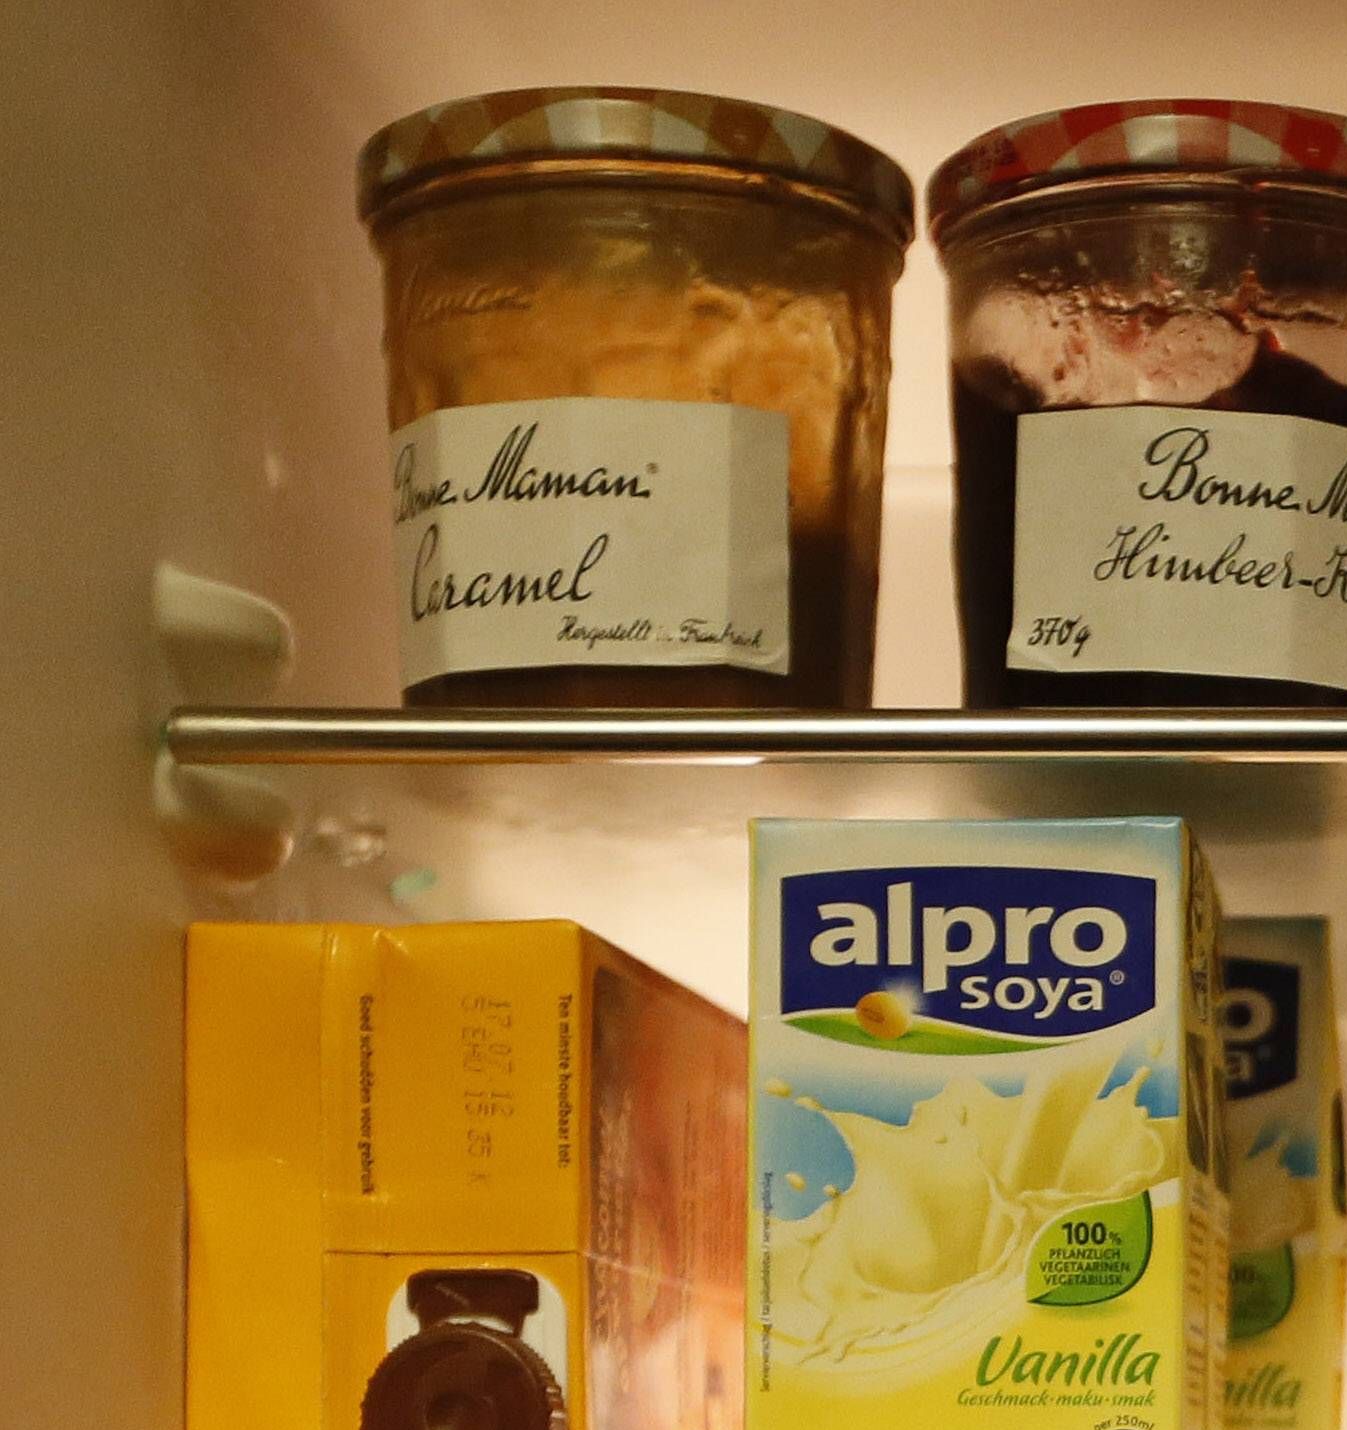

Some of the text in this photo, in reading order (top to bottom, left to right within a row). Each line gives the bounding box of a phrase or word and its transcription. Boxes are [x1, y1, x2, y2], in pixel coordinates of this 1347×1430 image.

[464, 421, 650, 501] Maman
[1139, 426, 1301, 512] Bonne
[411, 523, 610, 622] Caramel
[1028, 614, 1092, 657] 370g
[810, 881, 1128, 993] alpro
[960, 975, 1104, 1020] soya
[1048, 1248, 1121, 1261] PFLANZLICH
[1061, 1221, 1122, 1247] 100%
[975, 1332, 1162, 1387] Vanilla
